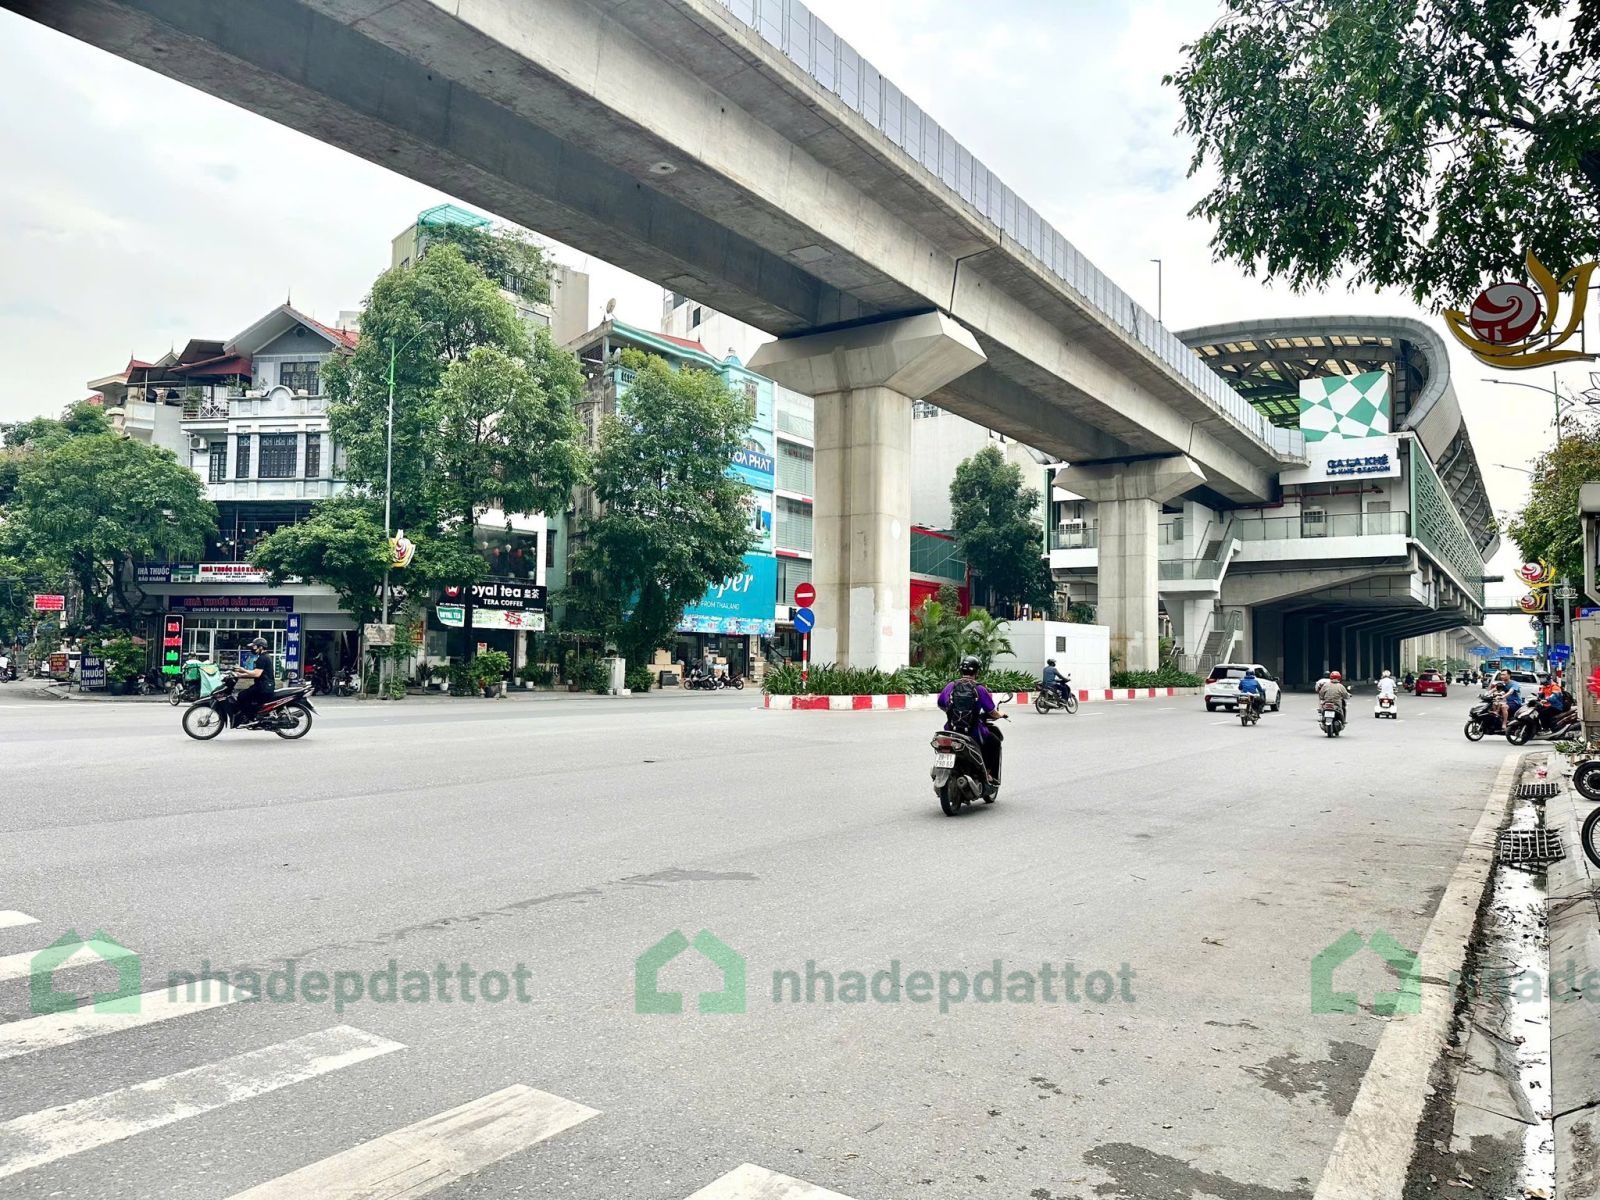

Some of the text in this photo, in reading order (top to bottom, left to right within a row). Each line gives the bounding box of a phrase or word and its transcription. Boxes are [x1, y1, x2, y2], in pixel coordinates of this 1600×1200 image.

[1327, 459, 1343, 468] GA
[1346, 458, 1361, 467] LA
[1356, 465, 1390, 473] STATION
[150, 565, 170, 575] THUỐC
[501, 585, 521, 598] tea
[483, 598, 523, 607] TERA COFFEE
[700, 600, 715, 609] FROM
[716, 601, 740, 610] THAILAND
[82, 667, 104, 678] THUỐC
